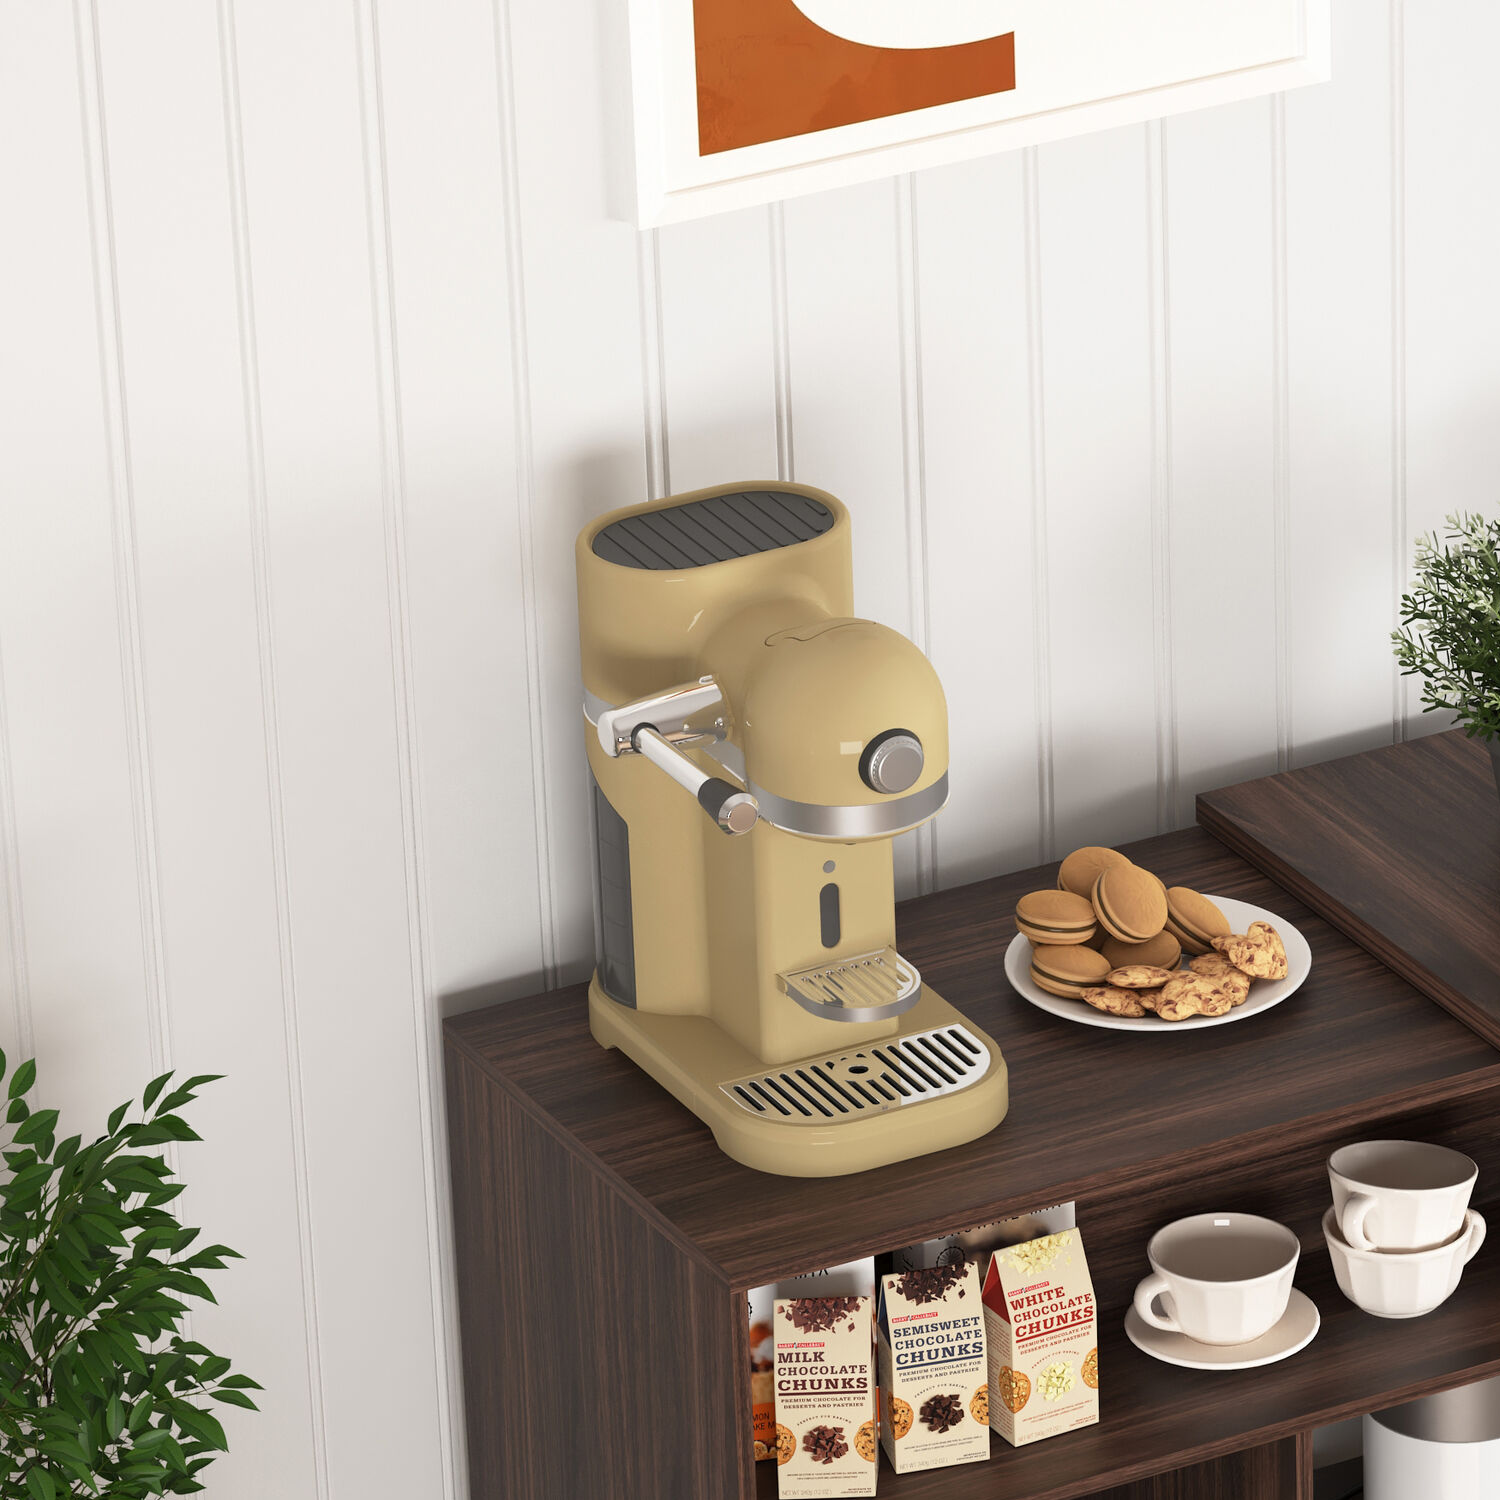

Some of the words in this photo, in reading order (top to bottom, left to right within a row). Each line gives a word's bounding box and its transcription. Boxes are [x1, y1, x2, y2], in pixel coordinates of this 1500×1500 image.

[1010, 1286, 1065, 1311] WHITE
[1014, 1293, 1092, 1323] CHOCOLATE
[894, 1316, 980, 1338] SEMISWEET
[1015, 1305, 1094, 1337] CHUNKS
[895, 1329, 982, 1350] CHOCOLATE
[1018, 1338, 1045, 1350] PREMIUM
[1046, 1329, 1079, 1342] CHOCOLATE
[1020, 1343, 1048, 1355] DESSERTS
[1050, 1339, 1062, 1347] AND
[1063, 1331, 1090, 1343] PASTRIES
[778, 1352, 825, 1363] MILK
[896, 1342, 983, 1365] CHUNKS
[778, 1365, 867, 1376] CHOCOLATE
[899, 1368, 928, 1377] PREMIUM
[930, 1362, 967, 1372] CHOCOLATE
[901, 1374, 933, 1383] DESSERTS
[949, 1367, 979, 1375] PASTRIES
[778, 1377, 868, 1391] CHUNKS
